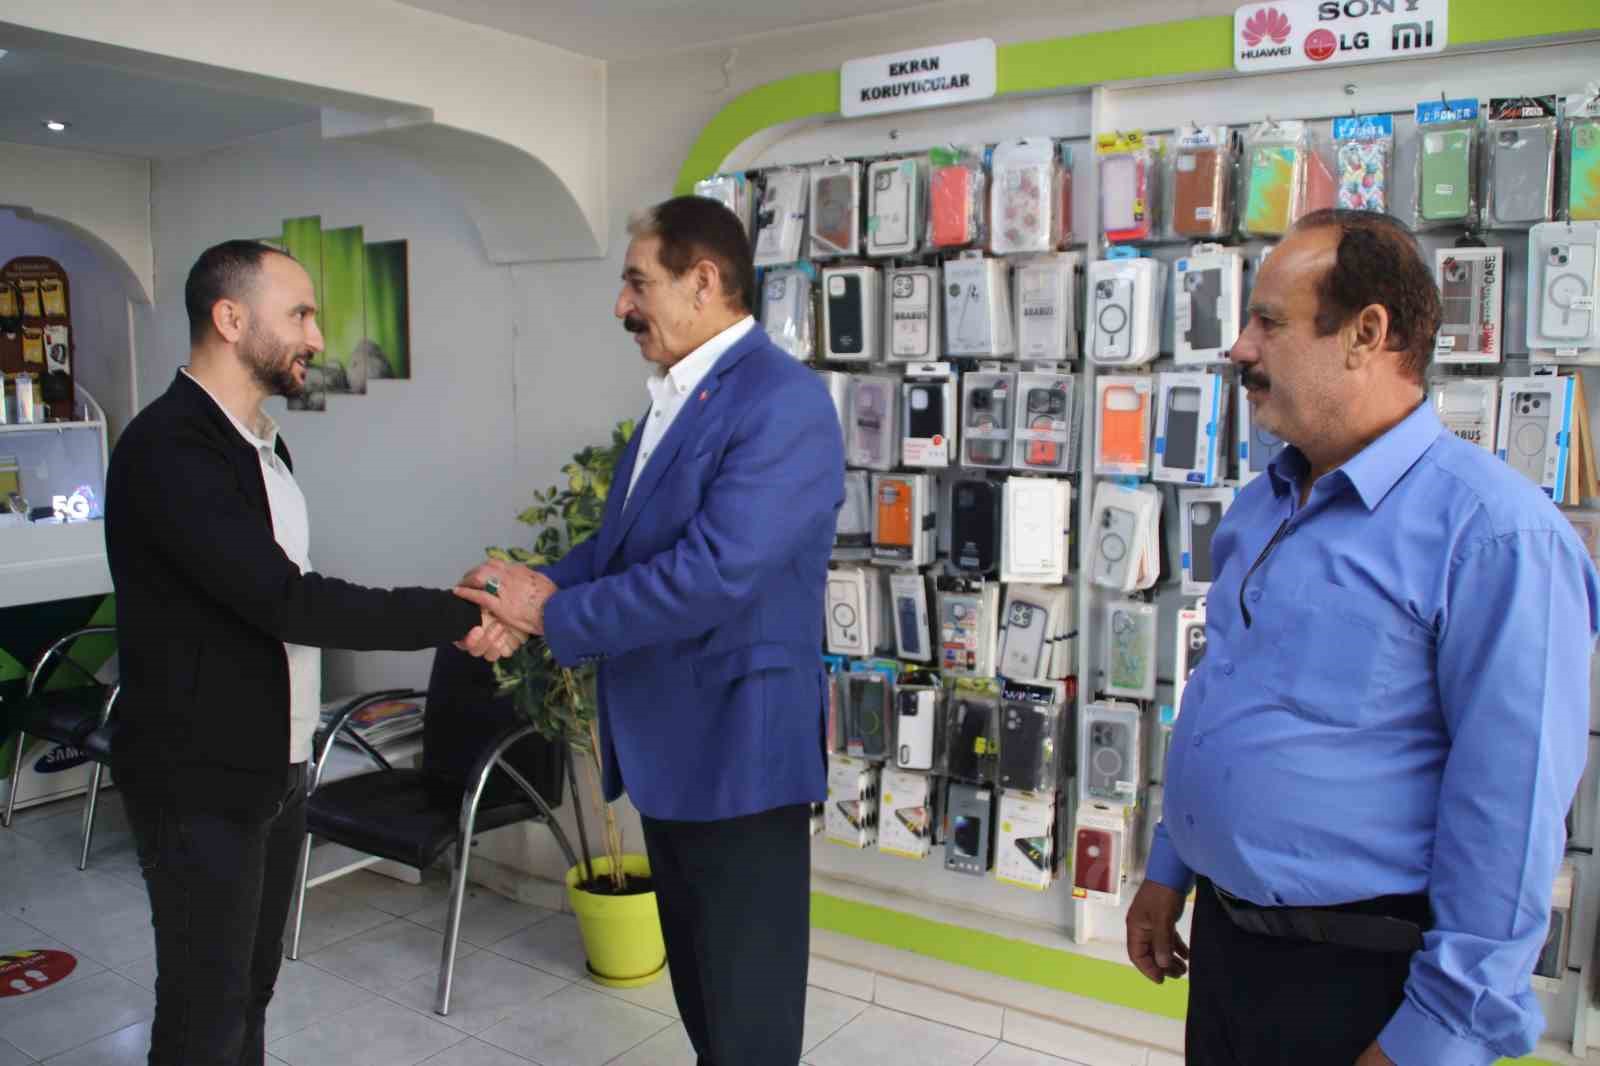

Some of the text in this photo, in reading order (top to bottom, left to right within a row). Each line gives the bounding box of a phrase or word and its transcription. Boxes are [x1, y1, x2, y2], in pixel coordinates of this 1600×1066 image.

[1318, 0, 1419, 21] SONY
[1340, 32, 1370, 51] LG
[1241, 47, 1292, 60] HUAWEI
[889, 56, 940, 76] EKRAN
[860, 73, 970, 102] KORUYUCULAR
[52, 495, 89, 519] 5G
